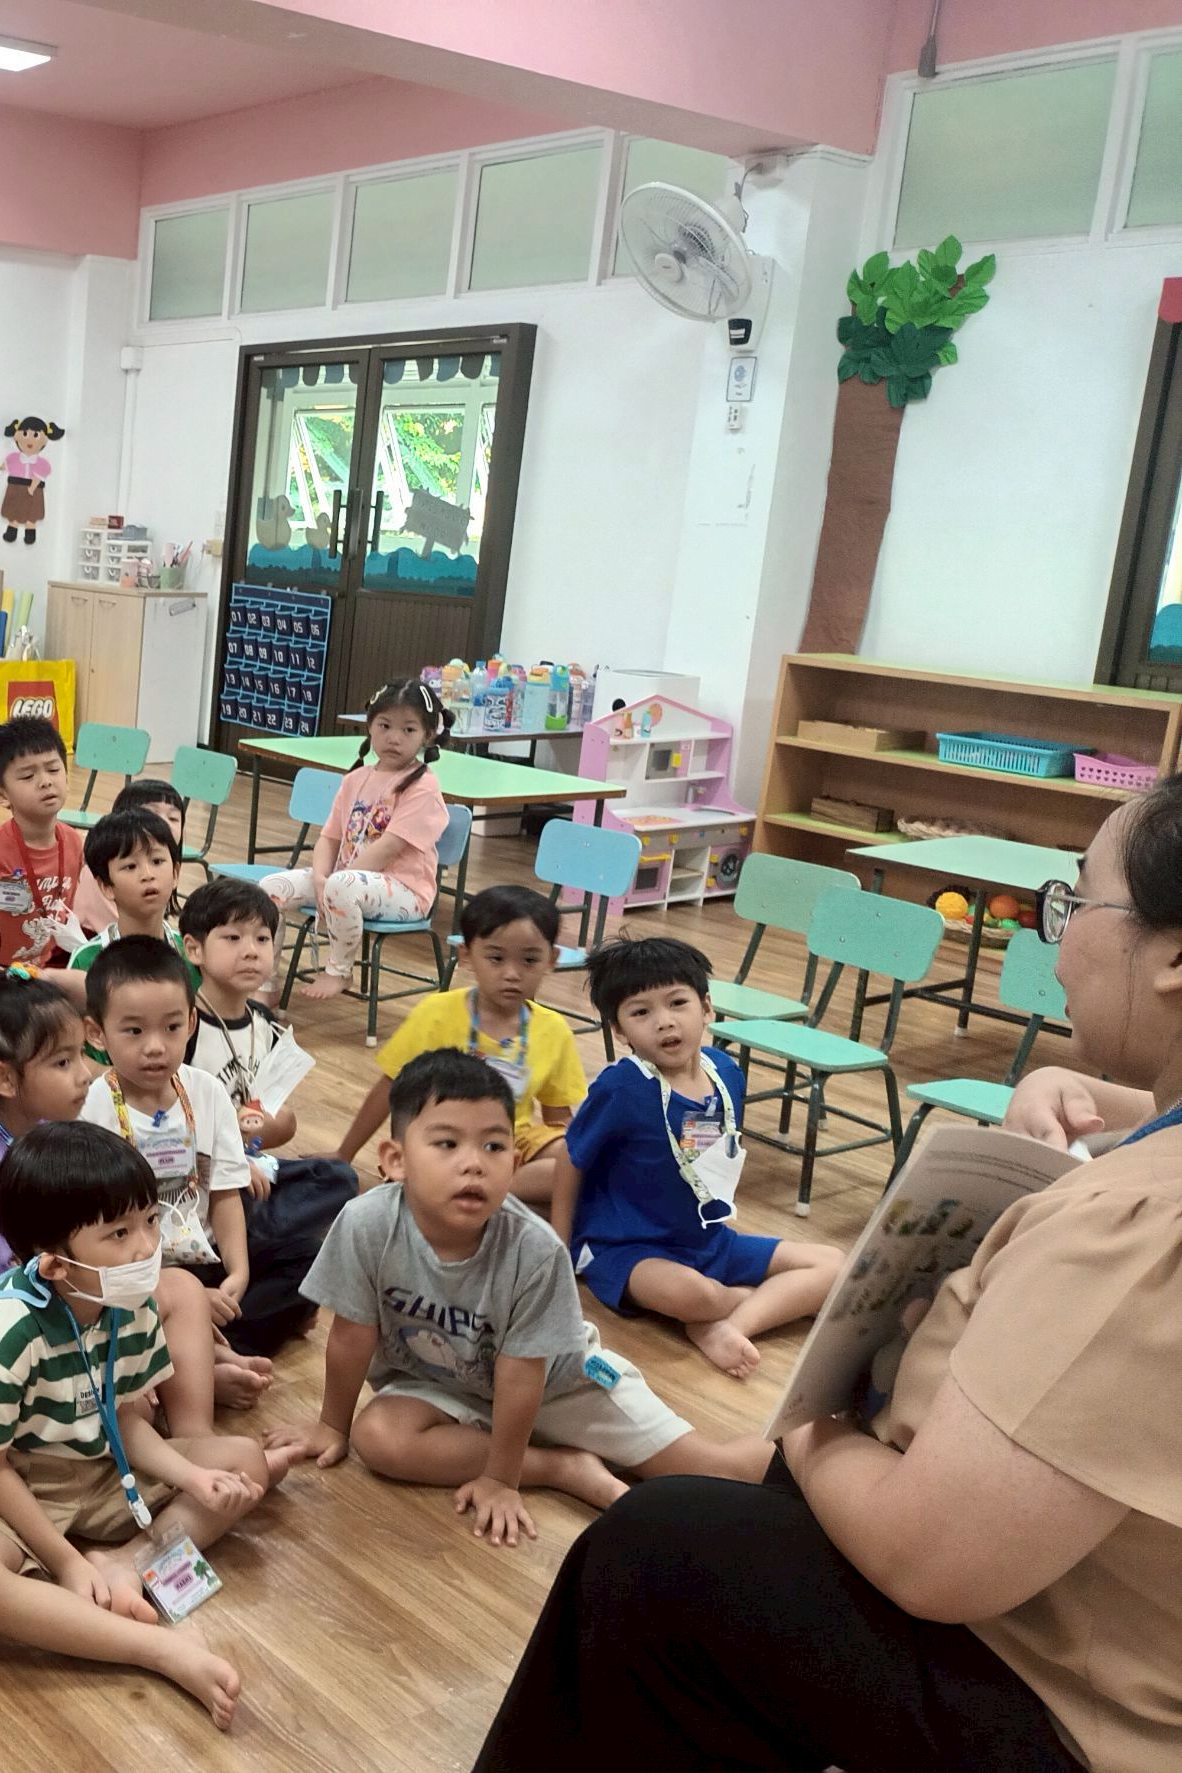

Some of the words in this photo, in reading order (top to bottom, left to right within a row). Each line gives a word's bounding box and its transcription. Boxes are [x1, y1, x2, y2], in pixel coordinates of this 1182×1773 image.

[231, 611, 242, 622] 01
[247, 613, 257, 625] 02
[261, 615, 271, 627] 03
[277, 619, 287, 631] 04
[293, 622, 304, 633] 05
[310, 624, 320, 636] 06
[228, 642, 237, 654] 07
[244, 644, 254, 656] 08
[258, 647, 268, 660] 09
[274, 650, 284, 662] 10
[291, 653, 300, 665] 11
[306, 656, 316, 669] 12
[226, 673, 236, 685] 13
[241, 676, 250, 687] 14
[254, 679, 263, 691] 15
[270, 682, 280, 695] 16
[287, 687, 296, 698] 17
[302, 690, 313, 702] 18
[12, 699, 54, 719] LEGO
[221, 703, 232, 716] 19
[238, 707, 247, 719] 20
[252, 710, 262, 723] 21
[267, 714, 277, 726] 22
[284, 717, 293, 729] 23
[300, 721, 310, 734] 24
